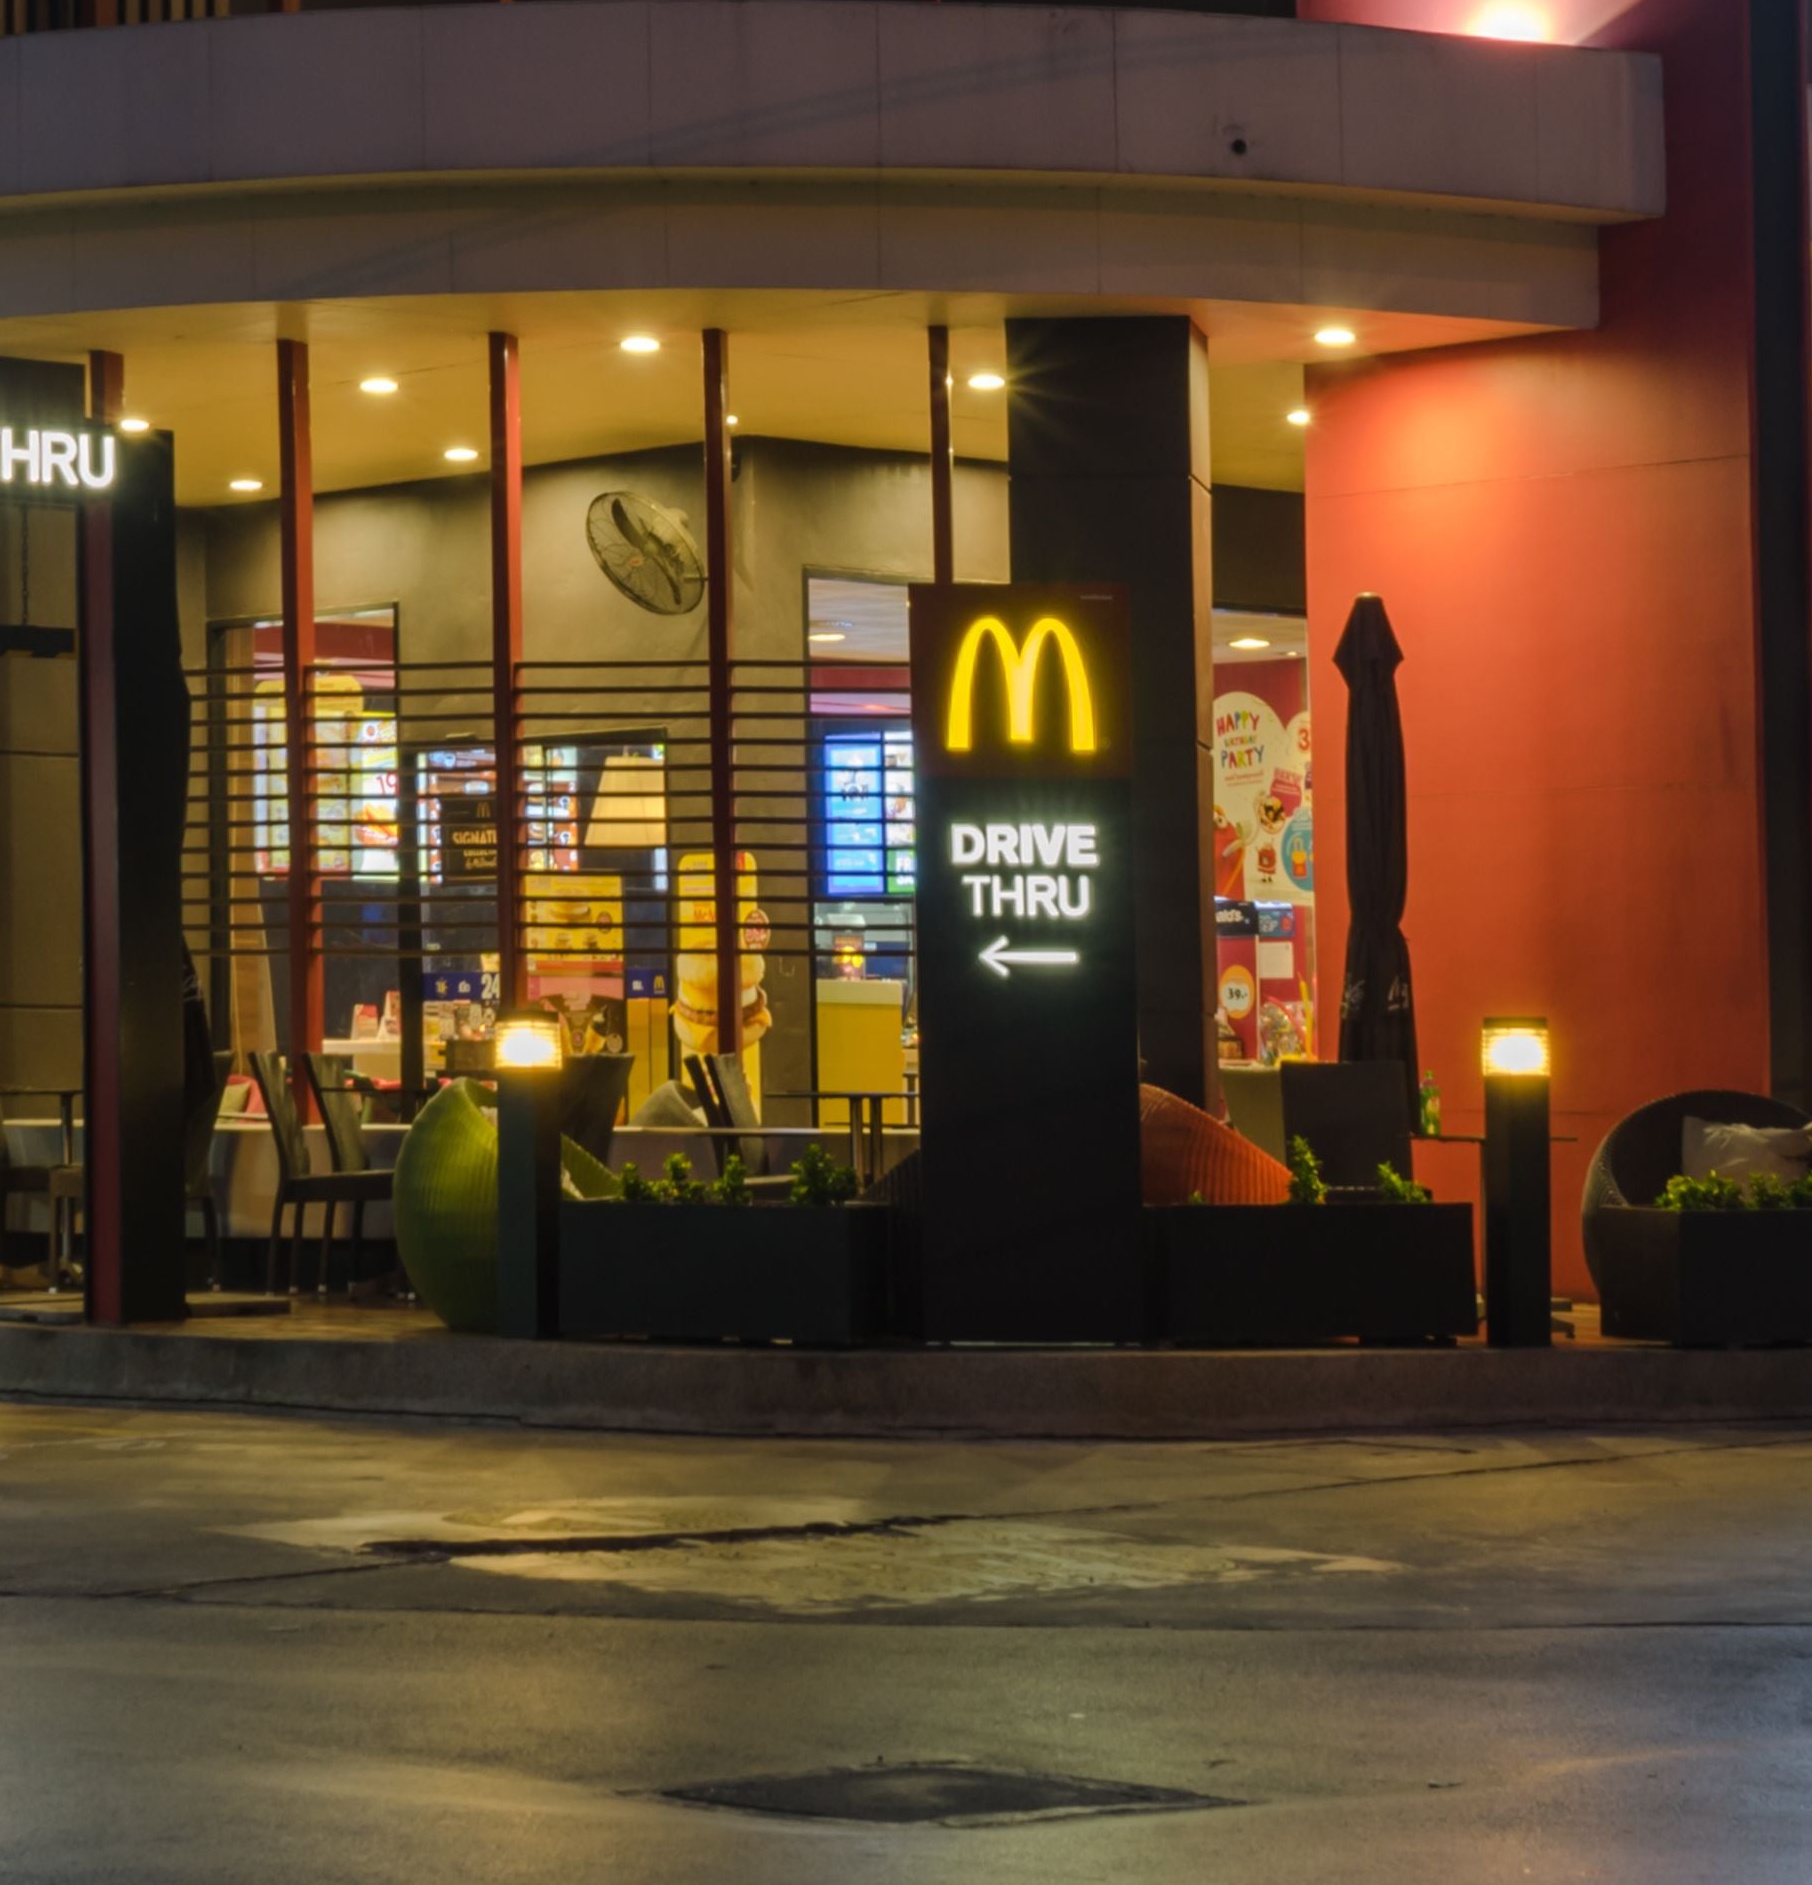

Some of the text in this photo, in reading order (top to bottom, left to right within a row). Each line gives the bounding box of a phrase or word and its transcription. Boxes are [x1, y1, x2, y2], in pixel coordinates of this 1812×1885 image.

[1216, 709, 1260, 737] HAPPY
[1220, 745, 1264, 769] PARTY
[950, 823, 1099, 867] DRIVE
[961, 874, 1090, 919] THRU
